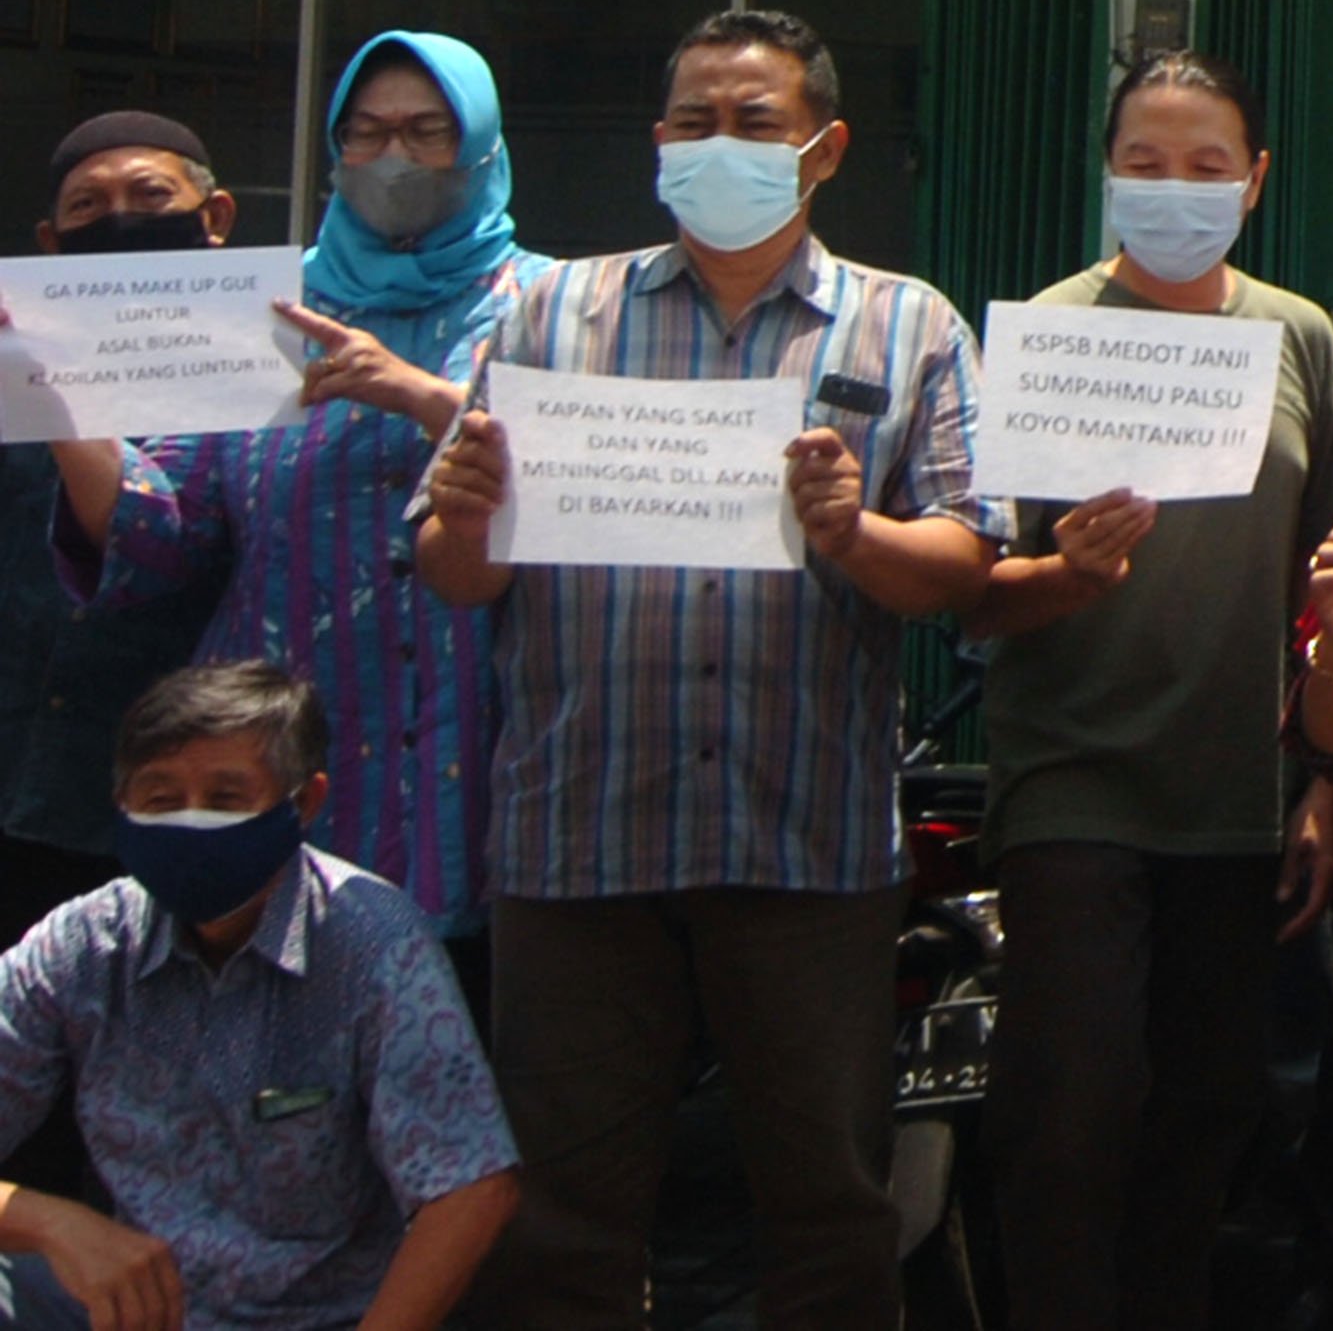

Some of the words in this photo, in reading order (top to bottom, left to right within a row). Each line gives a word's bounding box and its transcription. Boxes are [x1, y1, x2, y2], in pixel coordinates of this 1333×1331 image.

[43, 283, 72, 300] GA
[76, 281, 127, 298] PAPA
[131, 278, 184, 296] MAKE
[190, 277, 217, 294] UP
[220, 274, 259, 292] GUE
[115, 306, 192, 324] LUNTUR
[97, 337, 142, 355] ASAL
[146, 333, 212, 351] BUKAN
[1020, 332, 1092, 357] KSPSB
[1098, 338, 1187, 364] MEDOT
[1190, 346, 1250, 369] JANJI
[125, 363, 177, 382] YANG
[181, 360, 256, 378] LUNTUR
[1018, 371, 1165, 405] SUMPAHMU
[1169, 386, 1244, 411] PALSU
[536, 398, 615, 420] KAPAN
[623, 404, 686, 426] YANG
[692, 407, 757, 428] SAKIT
[1004, 411, 1072, 436] KOYO
[1077, 417, 1216, 448] MANTANKU
[1220, 427, 1247, 449] !!!
[587, 433, 639, 453] DAN
[644, 437, 709, 458] YANG
[521, 458, 664, 484] MENINGGAL
[715, 469, 780, 489] AKAN
[558, 495, 582, 515] DI
[589, 497, 711, 519] BAYARKAN
